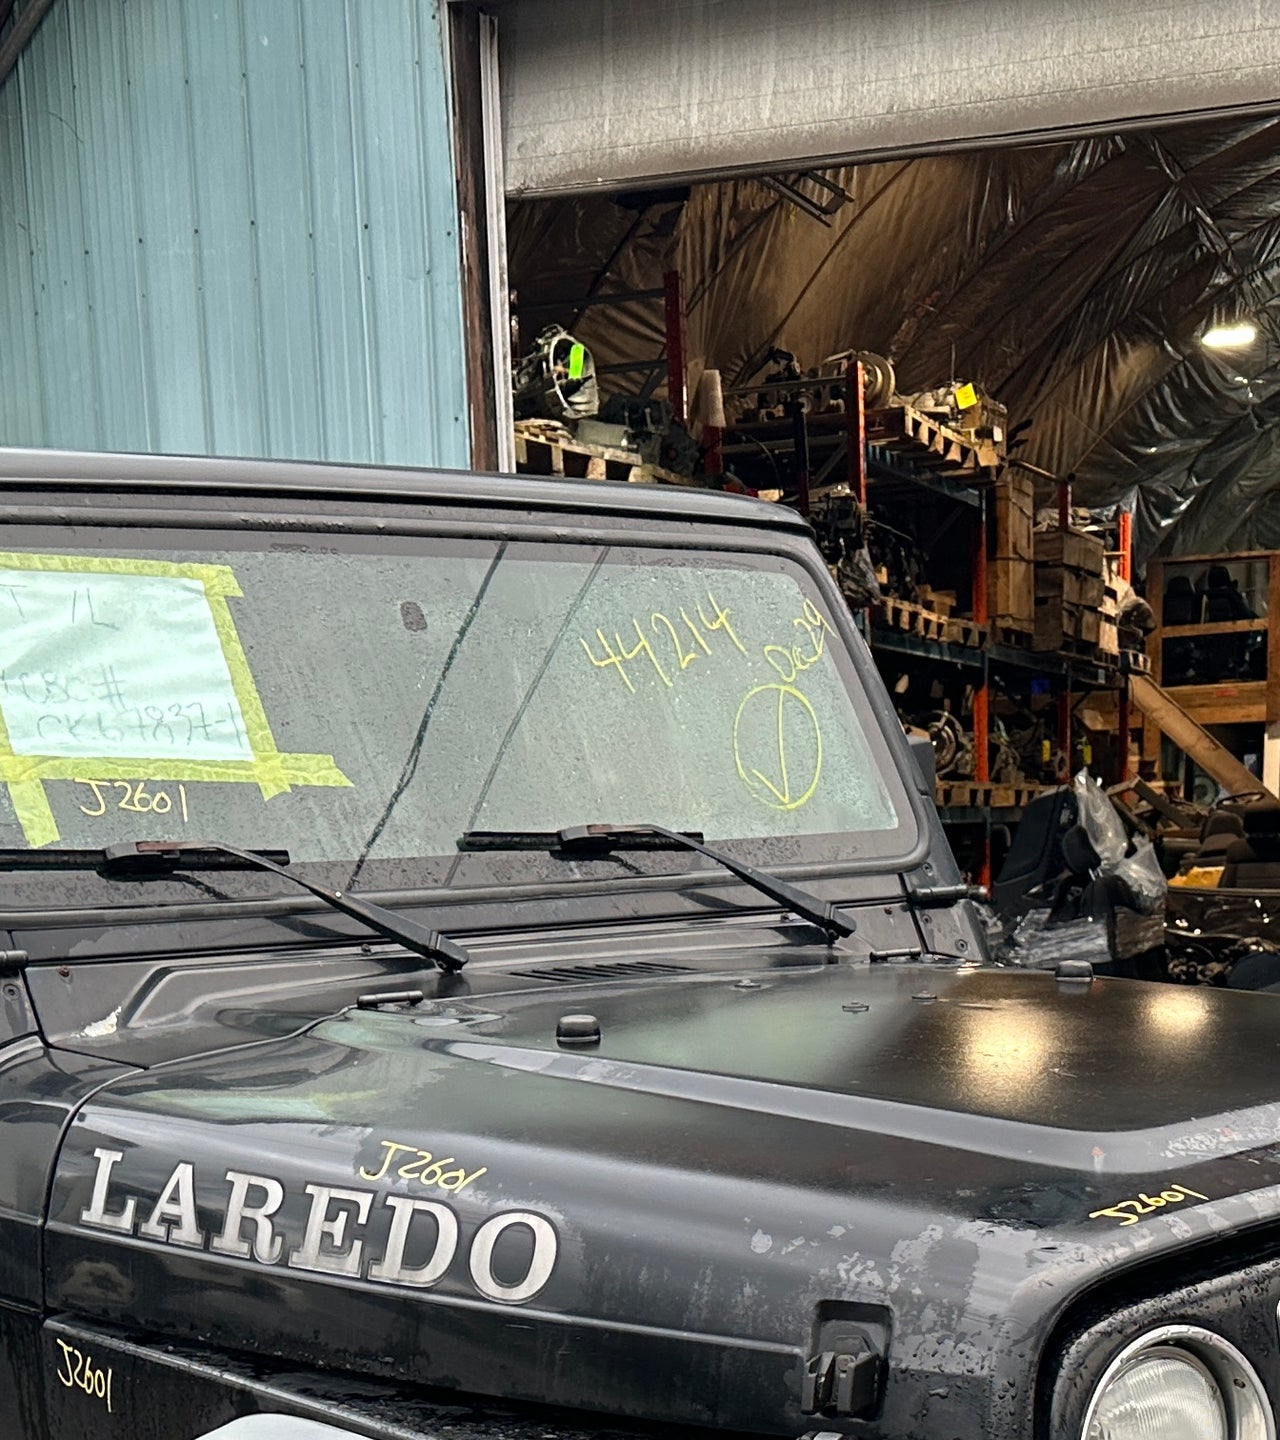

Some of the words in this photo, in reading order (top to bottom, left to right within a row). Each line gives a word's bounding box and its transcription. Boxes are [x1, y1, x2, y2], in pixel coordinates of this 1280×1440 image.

[578, 590, 750, 694] 44214
[72, 777, 191, 822] J2601
[359, 1140, 490, 1196] J2601
[79, 1146, 560, 1306] LAREDO
[1088, 1184, 1210, 1226] J2601
[56, 1338, 113, 1413] J2601
